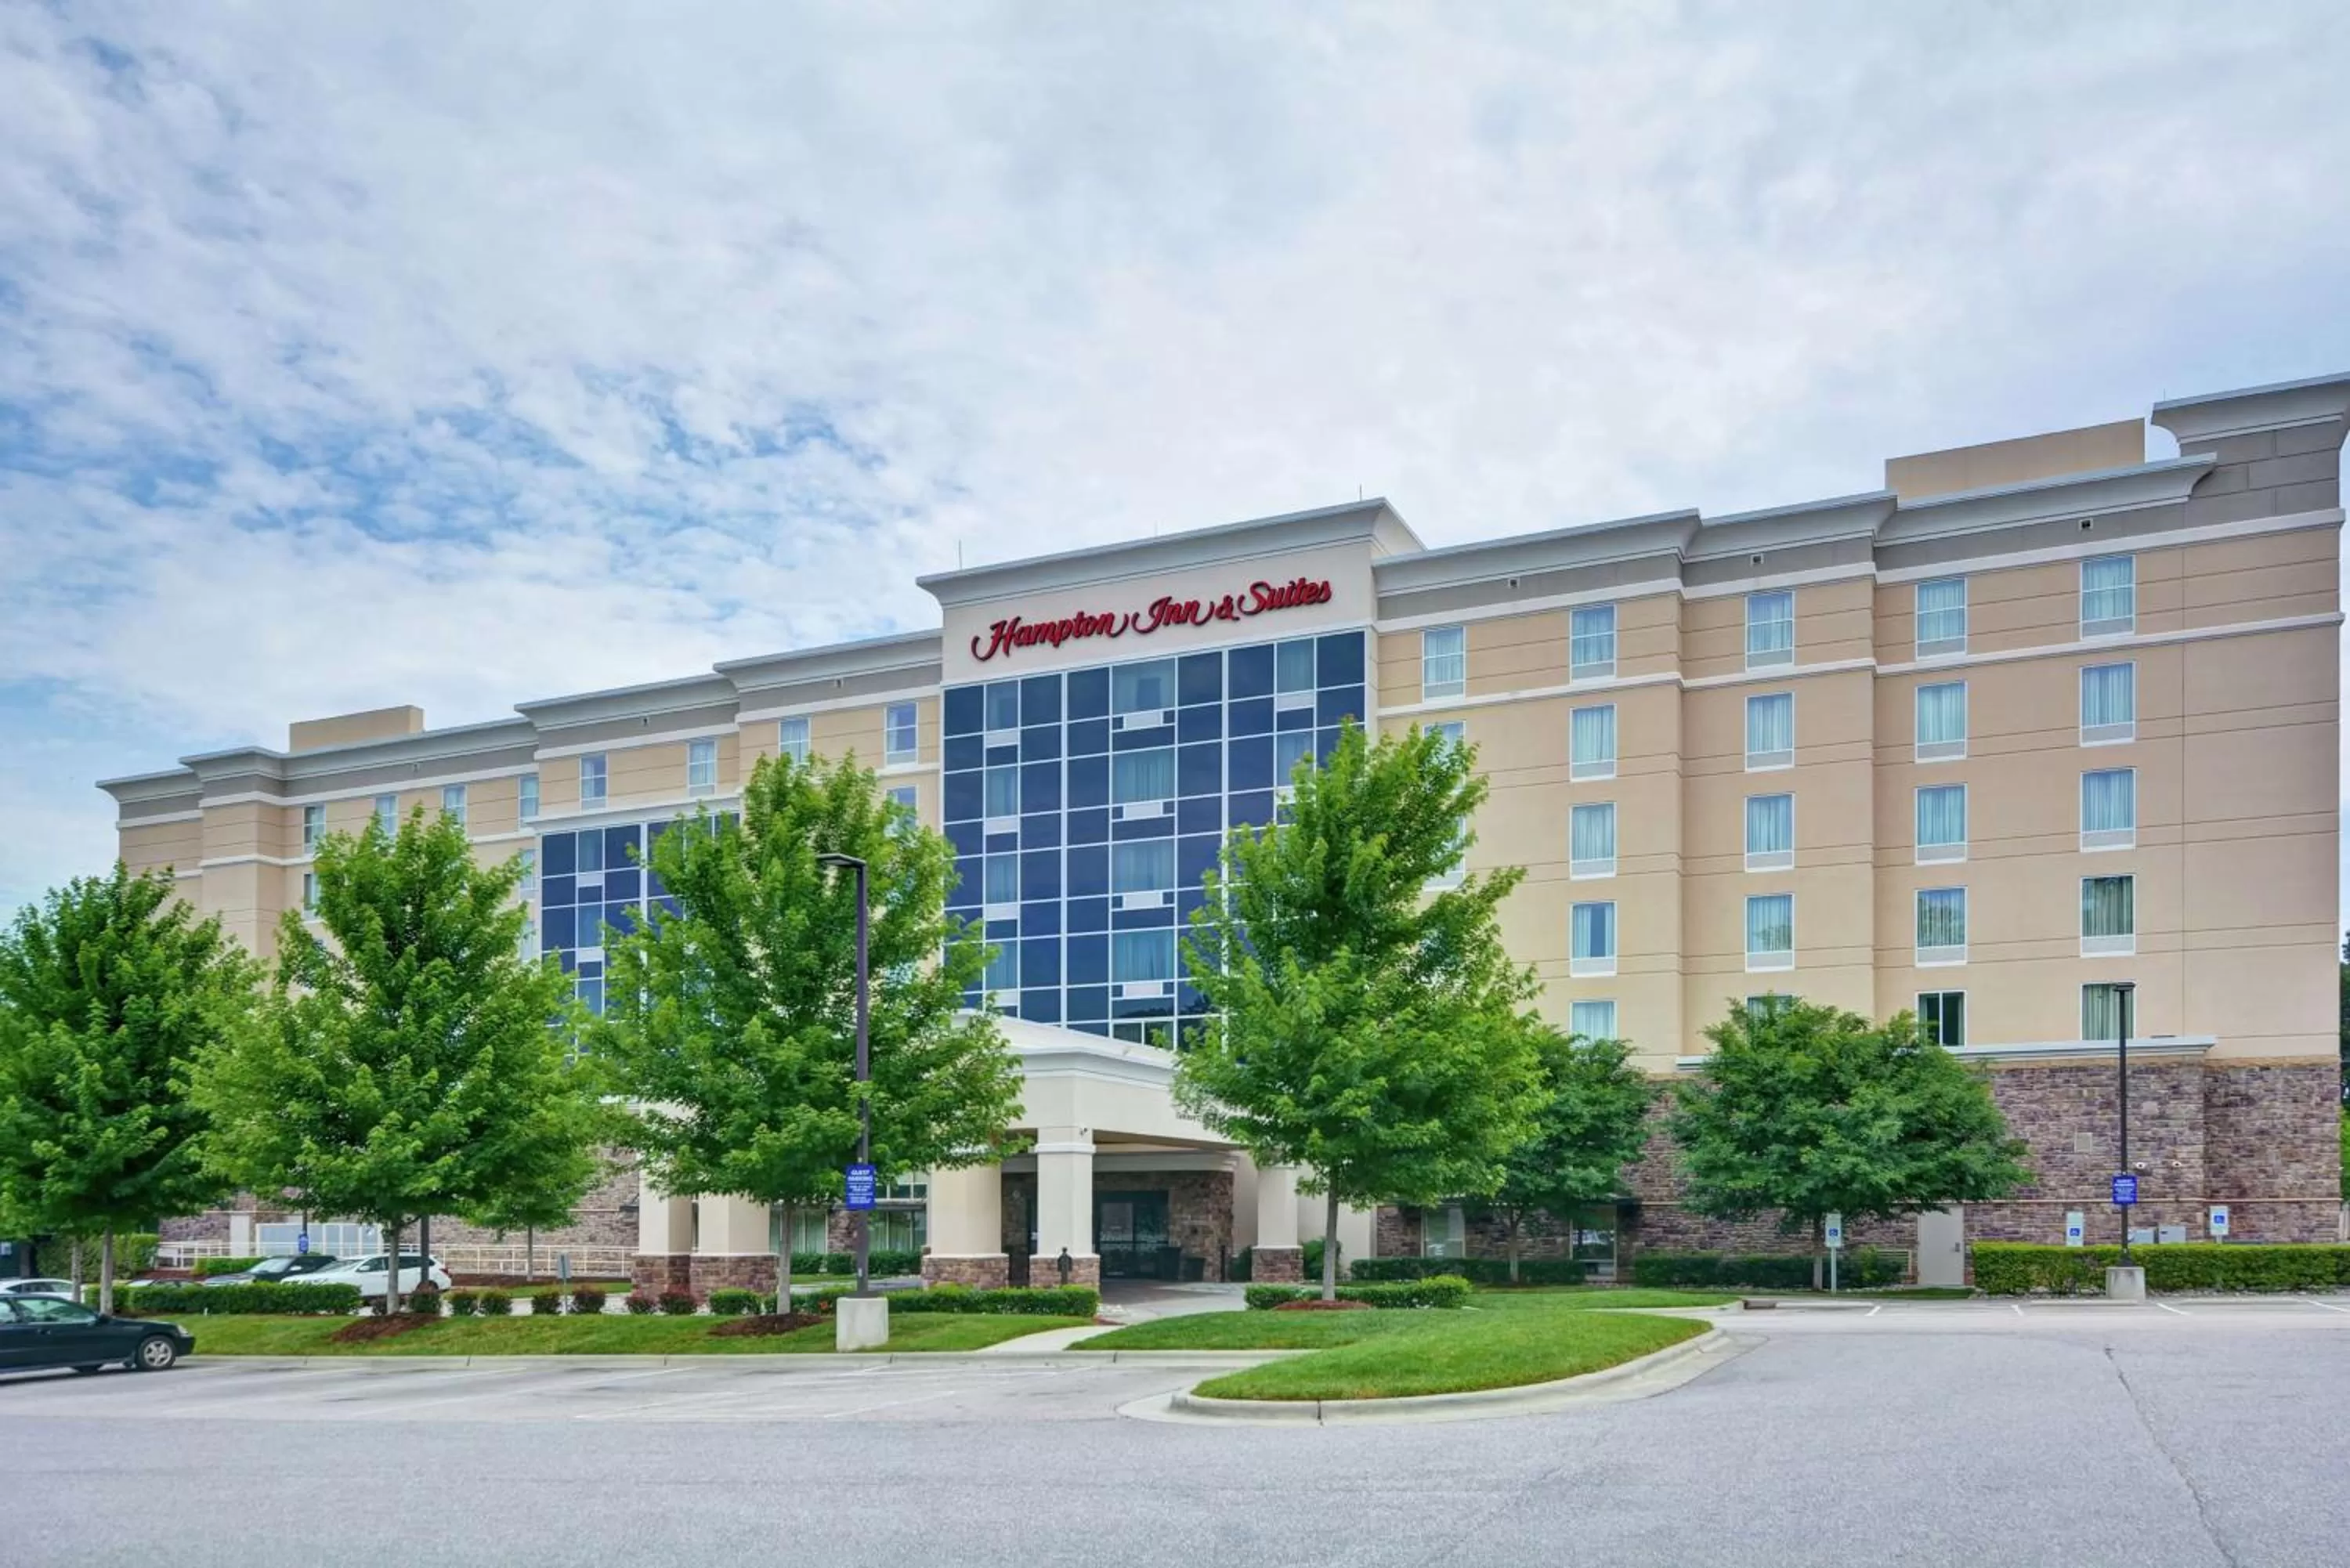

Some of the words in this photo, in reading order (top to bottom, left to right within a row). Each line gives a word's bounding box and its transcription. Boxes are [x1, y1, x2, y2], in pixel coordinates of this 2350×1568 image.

[971, 610, 1130, 661] Hampton
[1131, 595, 1215, 634] Inn
[1215, 594, 1240, 620] &
[1238, 577, 1332, 616] Suites
